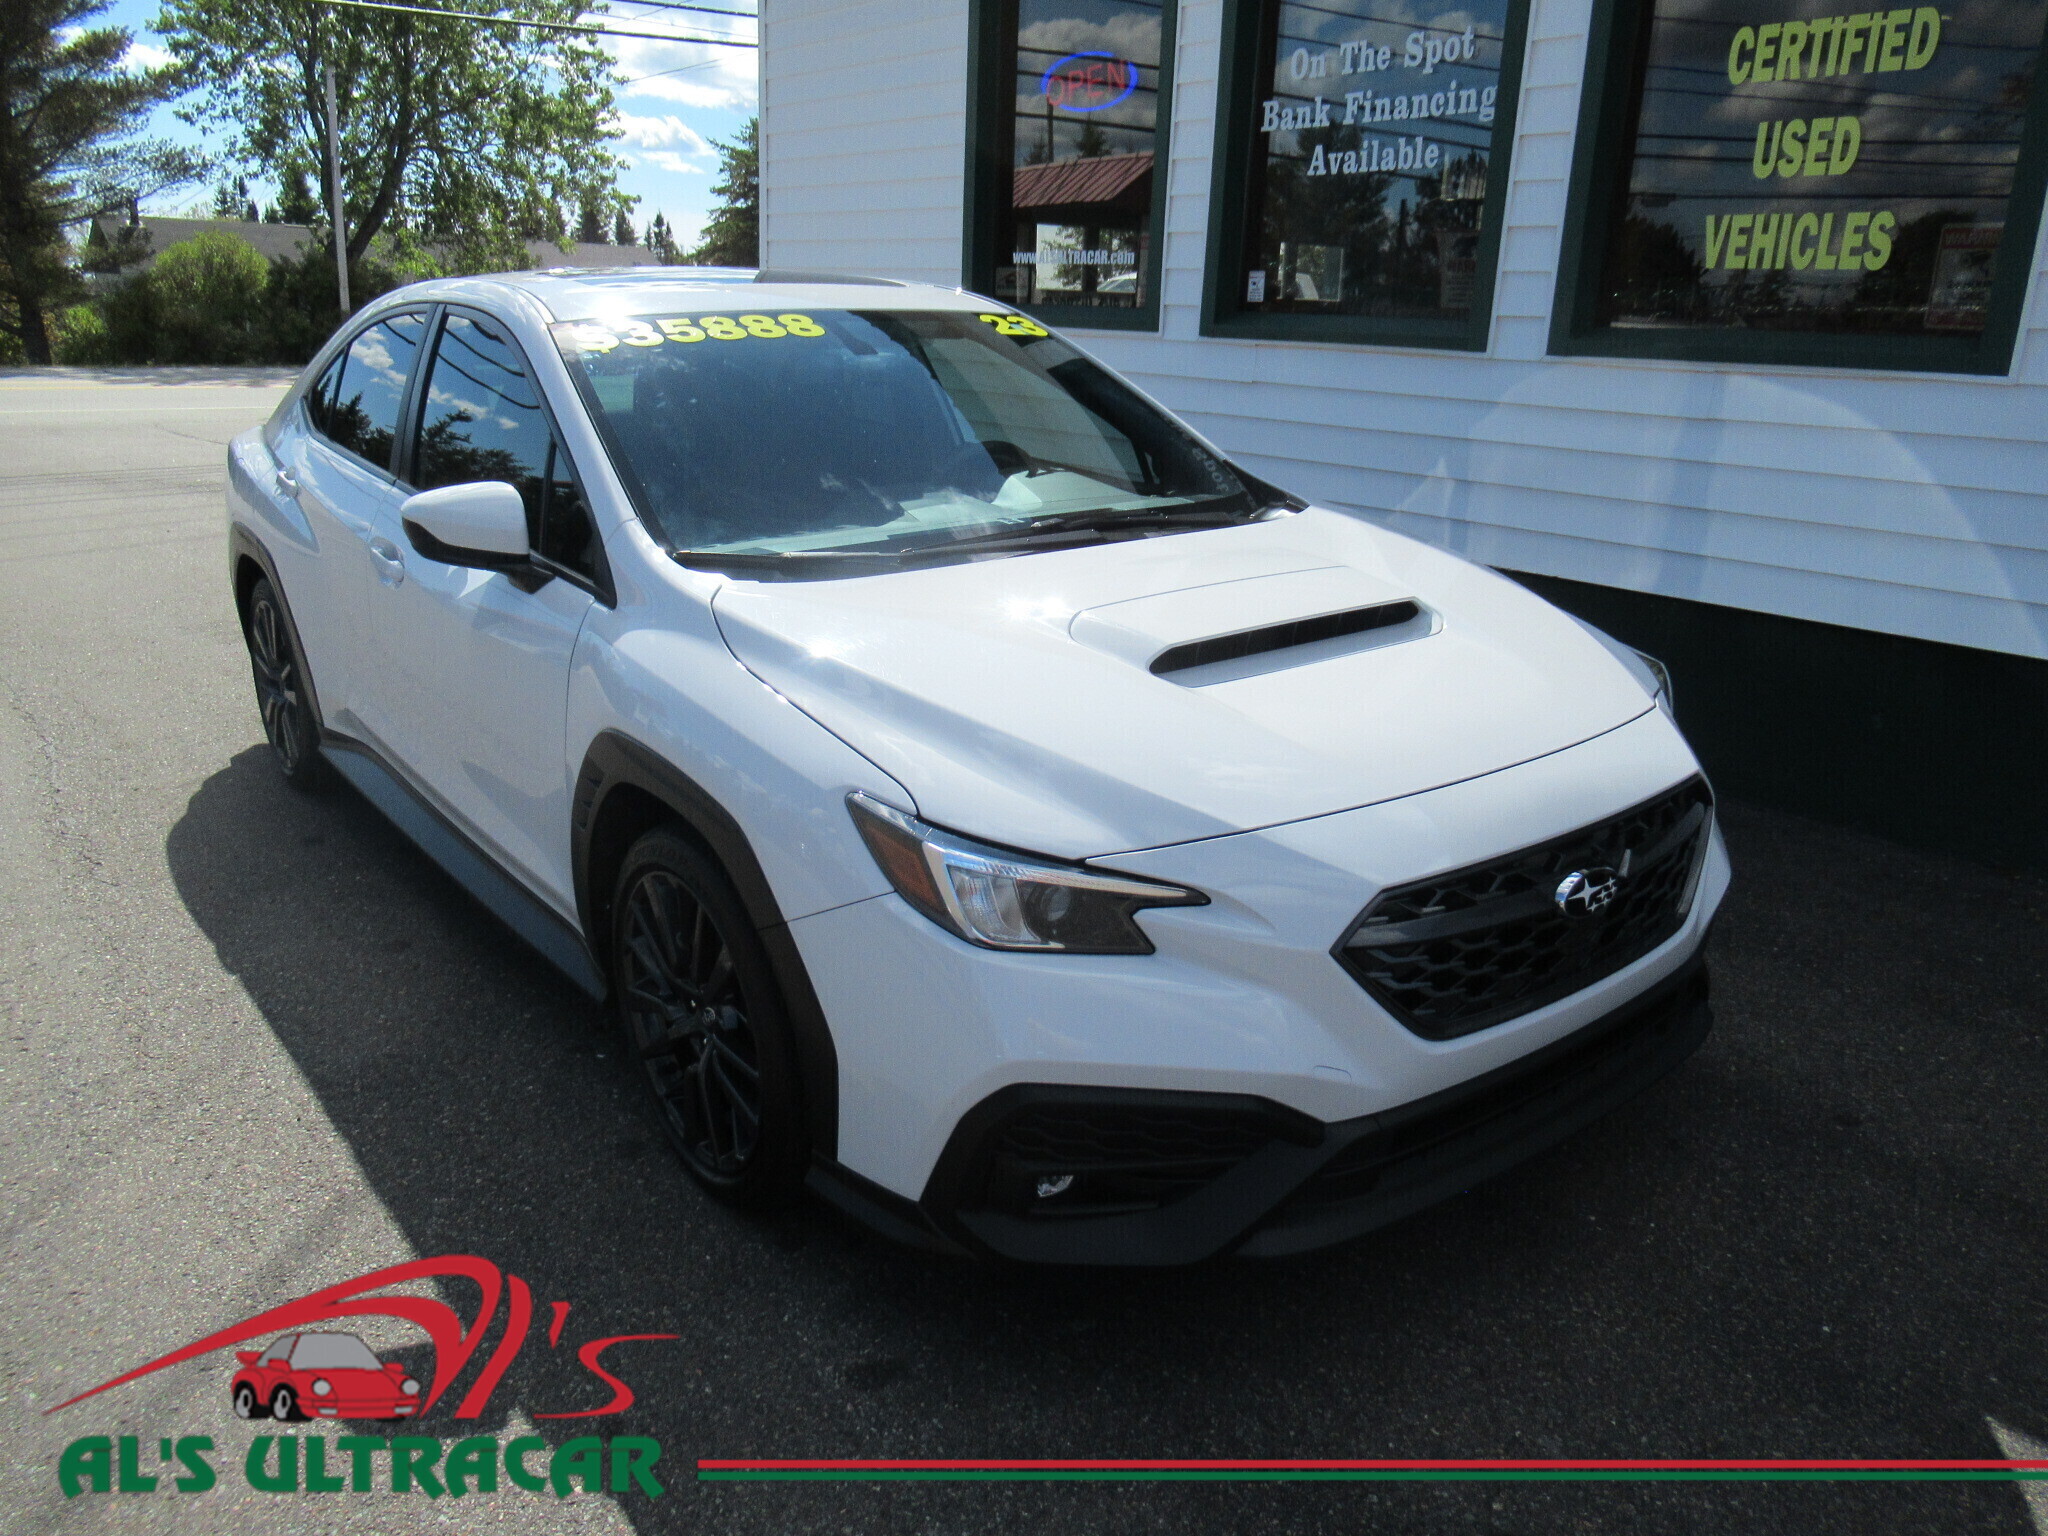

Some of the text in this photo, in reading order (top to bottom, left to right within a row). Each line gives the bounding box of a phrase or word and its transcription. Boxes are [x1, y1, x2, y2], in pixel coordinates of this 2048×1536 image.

[1290, 26, 1476, 81] On The Spot
[1727, 6, 1942, 86] CERTIFIED
[1046, 59, 1126, 106] OPEN
[1261, 81, 1498, 133] Bank Financing
[1307, 136, 1440, 178] Available
[1752, 115, 1861, 179] USED
[1705, 210, 1896, 272] VEHICLES
[572, 313, 826, 354] $35888
[979, 314, 1049, 337] 23
